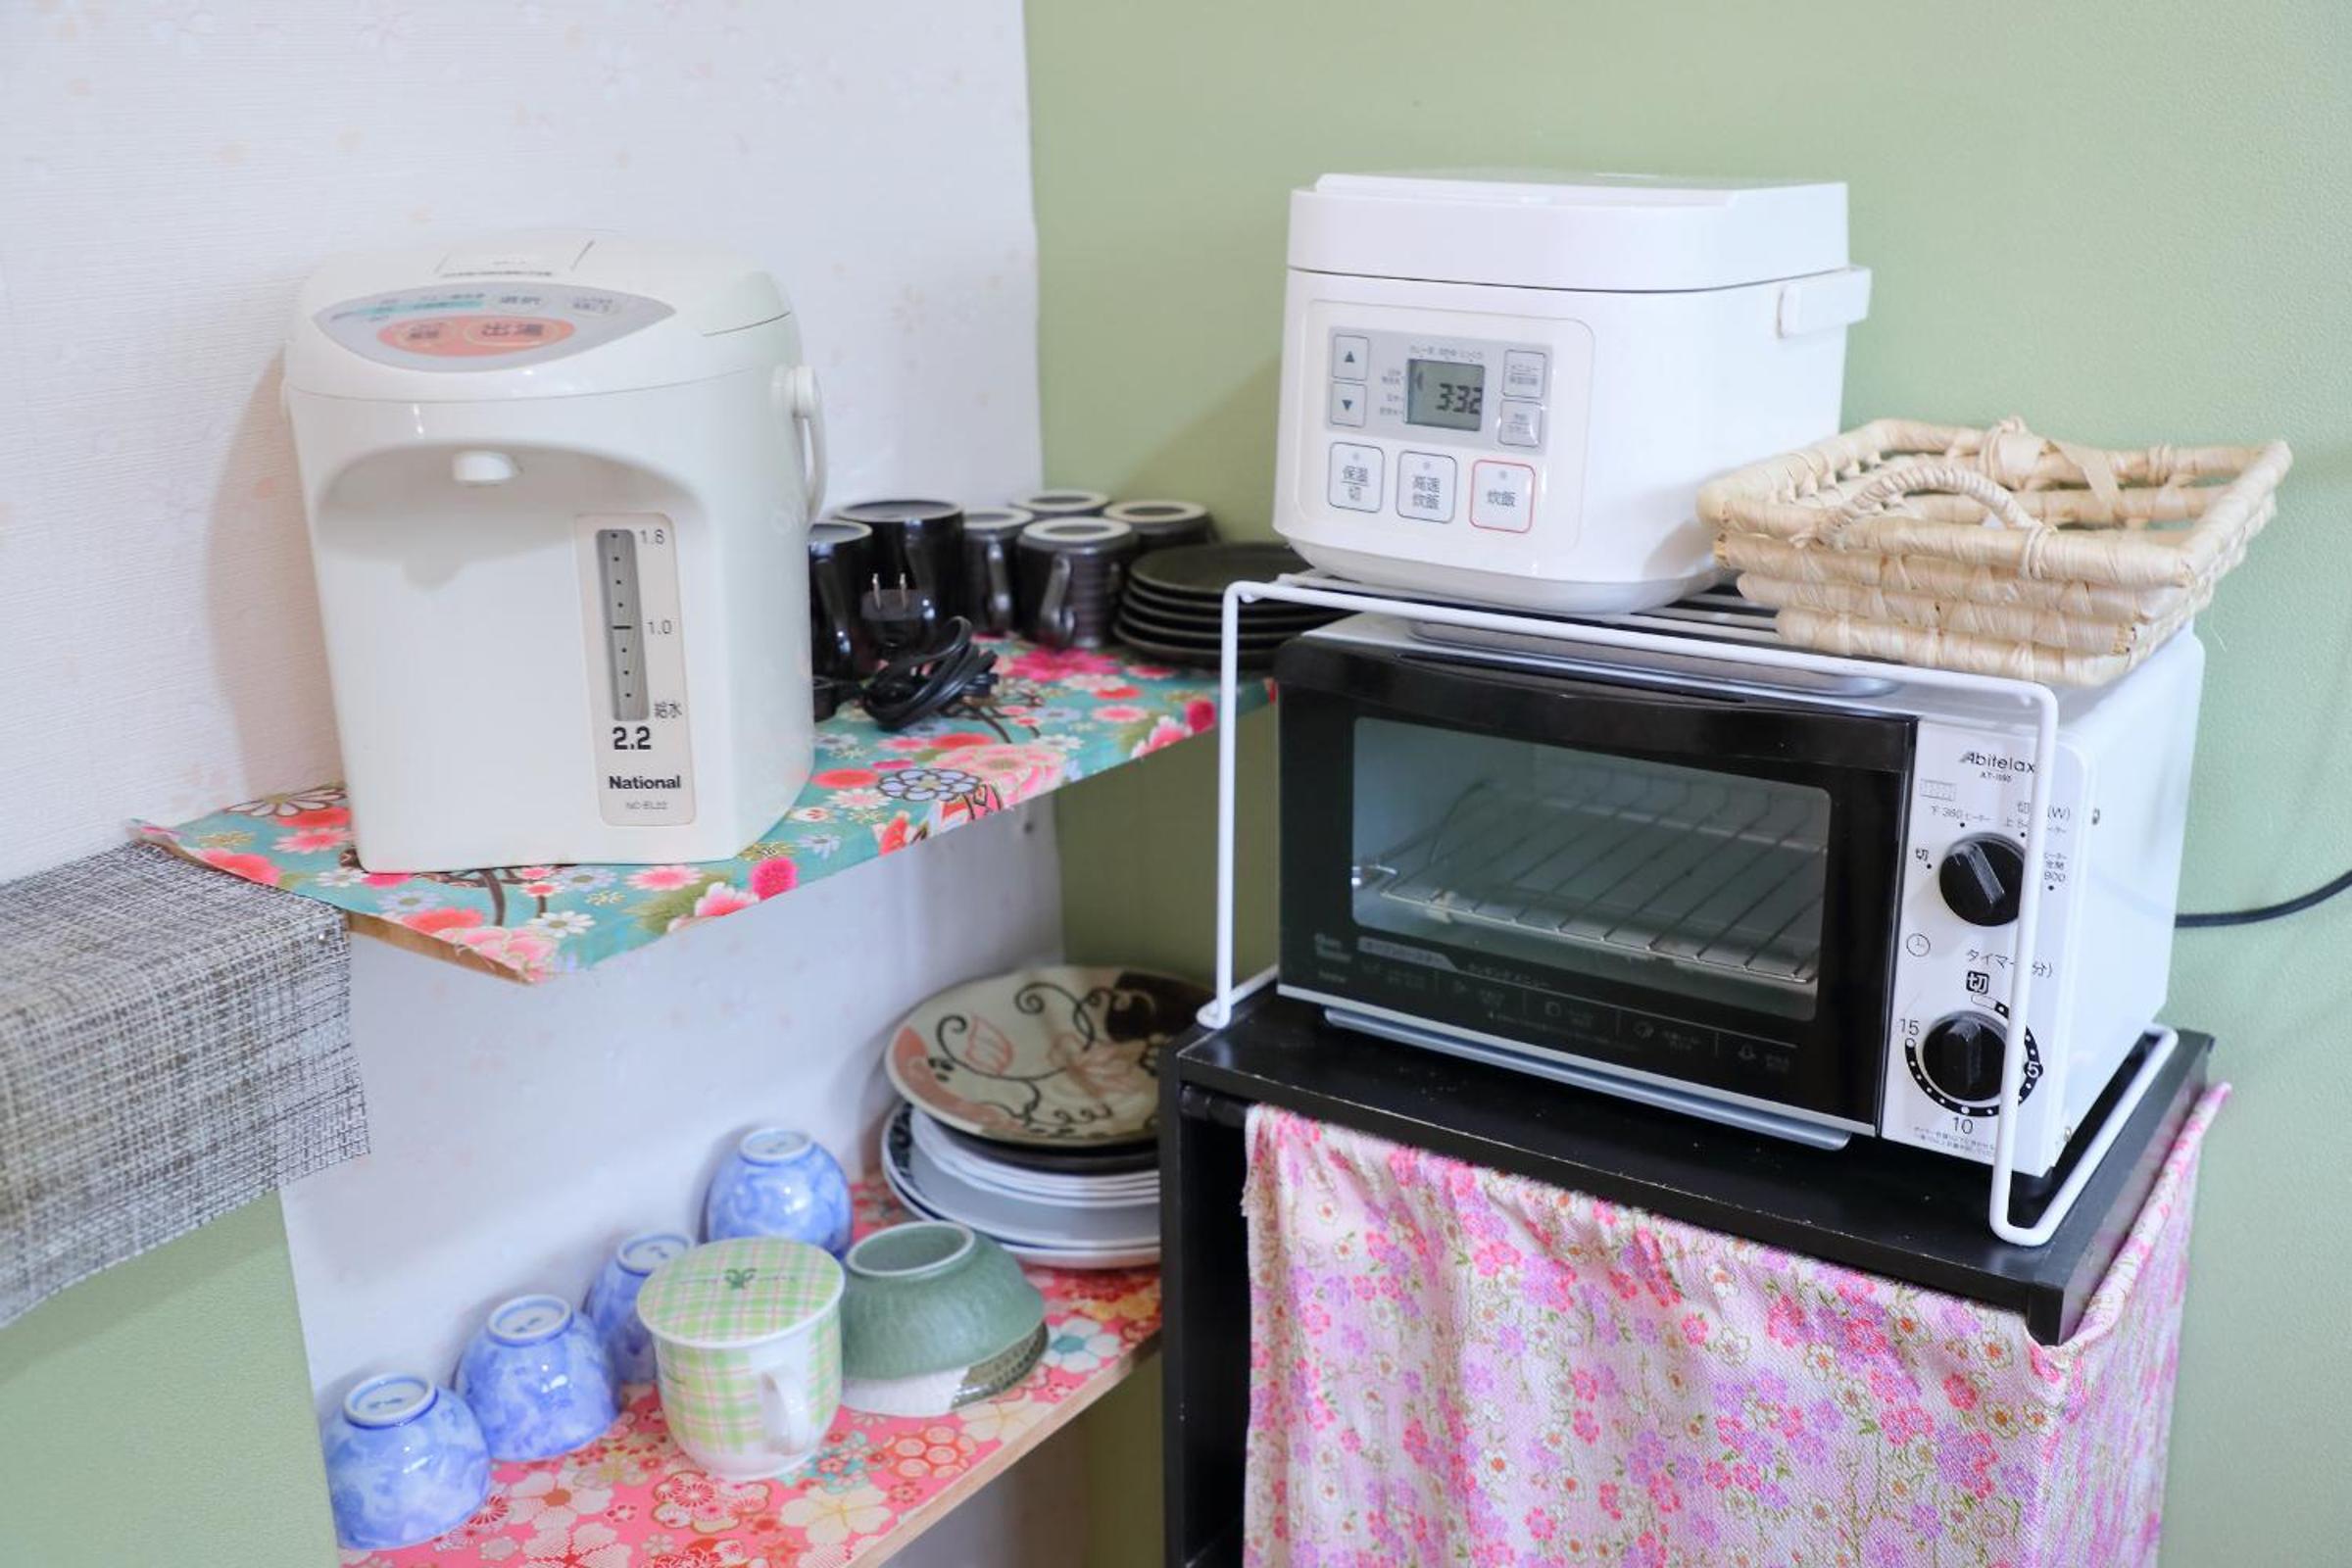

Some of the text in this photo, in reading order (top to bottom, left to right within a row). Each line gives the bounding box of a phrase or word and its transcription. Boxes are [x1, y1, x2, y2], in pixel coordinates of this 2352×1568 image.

[647, 619, 672, 635] 1.0
[612, 725, 652, 751] 2.2
[1960, 751, 2034, 774] Abitelax
[609, 774, 681, 790] National
[1967, 971, 1989, 994] 切
[1898, 1018, 1920, 1036] 15
[2027, 1062, 2039, 1077] 5
[1952, 1116, 1974, 1135] 10
